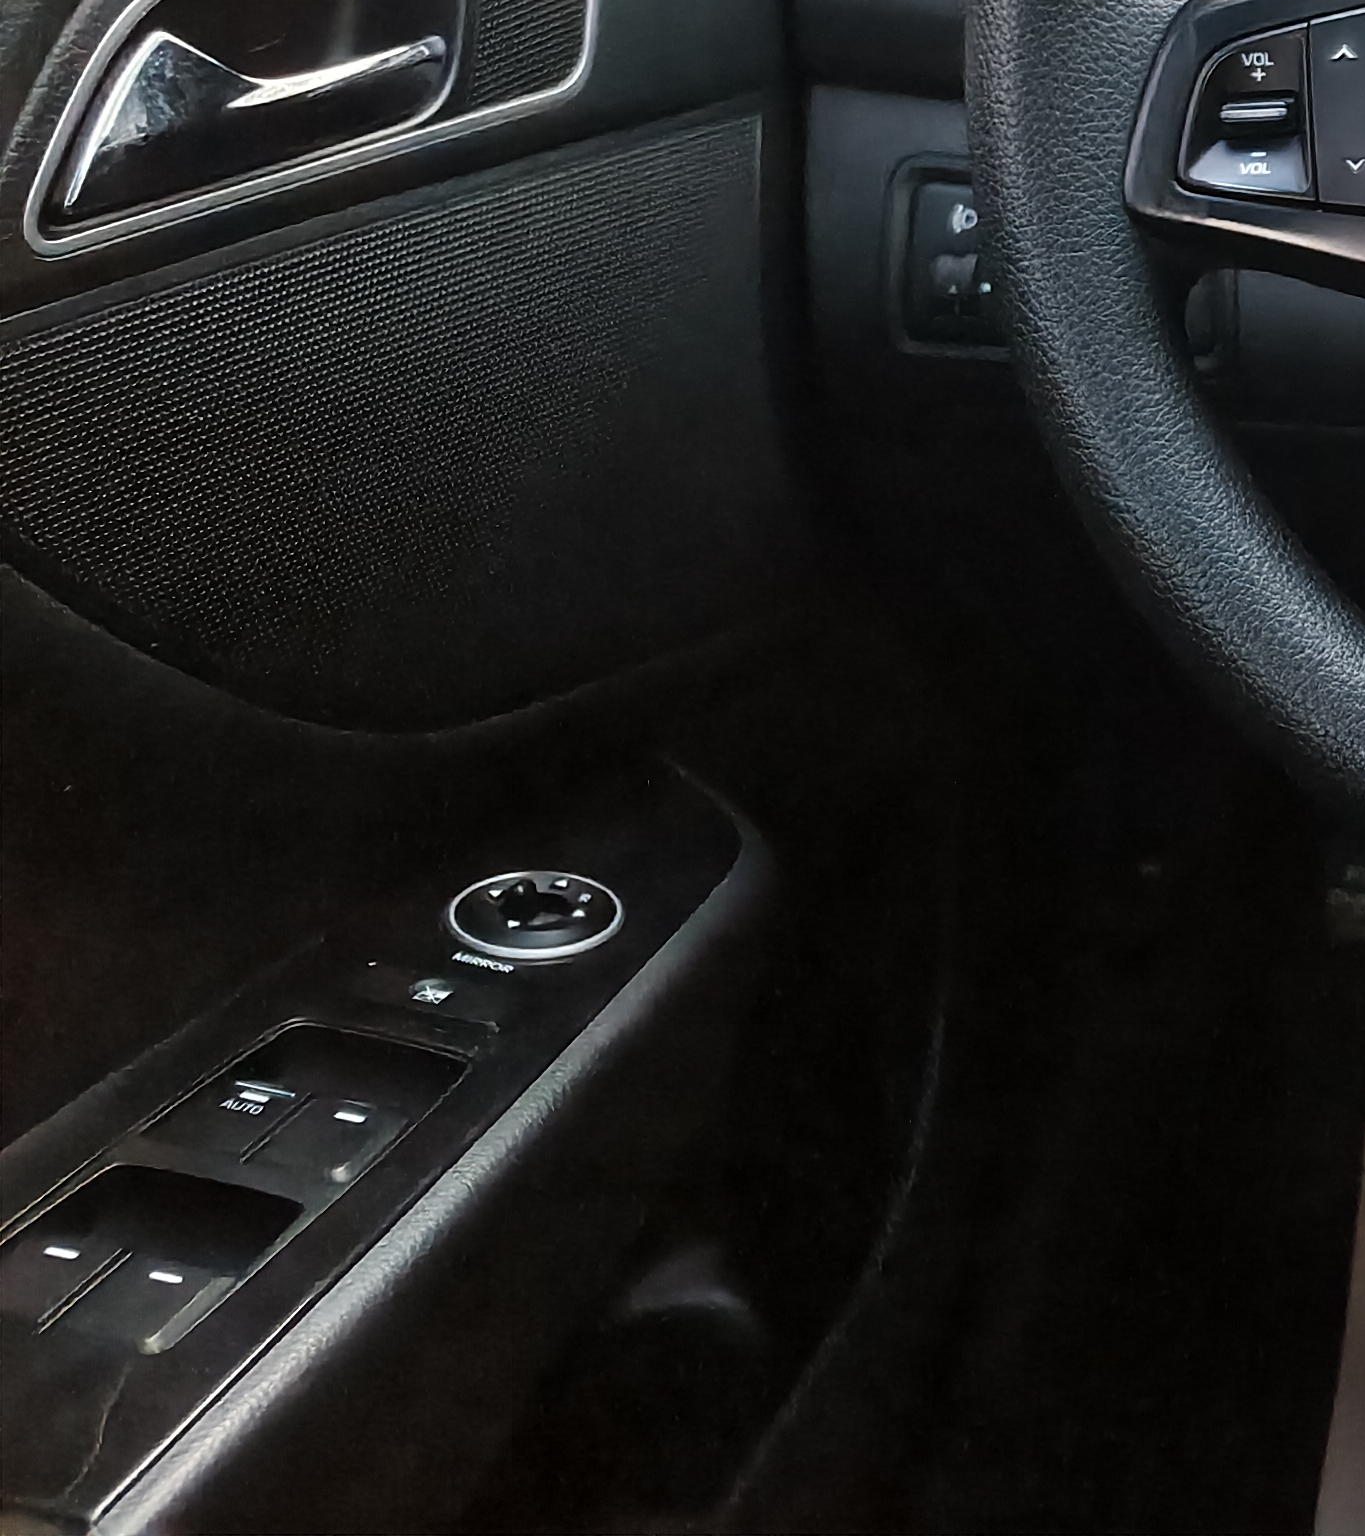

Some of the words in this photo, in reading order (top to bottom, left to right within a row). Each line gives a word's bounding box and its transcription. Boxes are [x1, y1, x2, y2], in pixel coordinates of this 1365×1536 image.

[1241, 52, 1274, 67] VOL
[1240, 162, 1271, 176] VOL
[452, 951, 515, 974] MIRROR
[219, 1097, 265, 1116] AUTO
